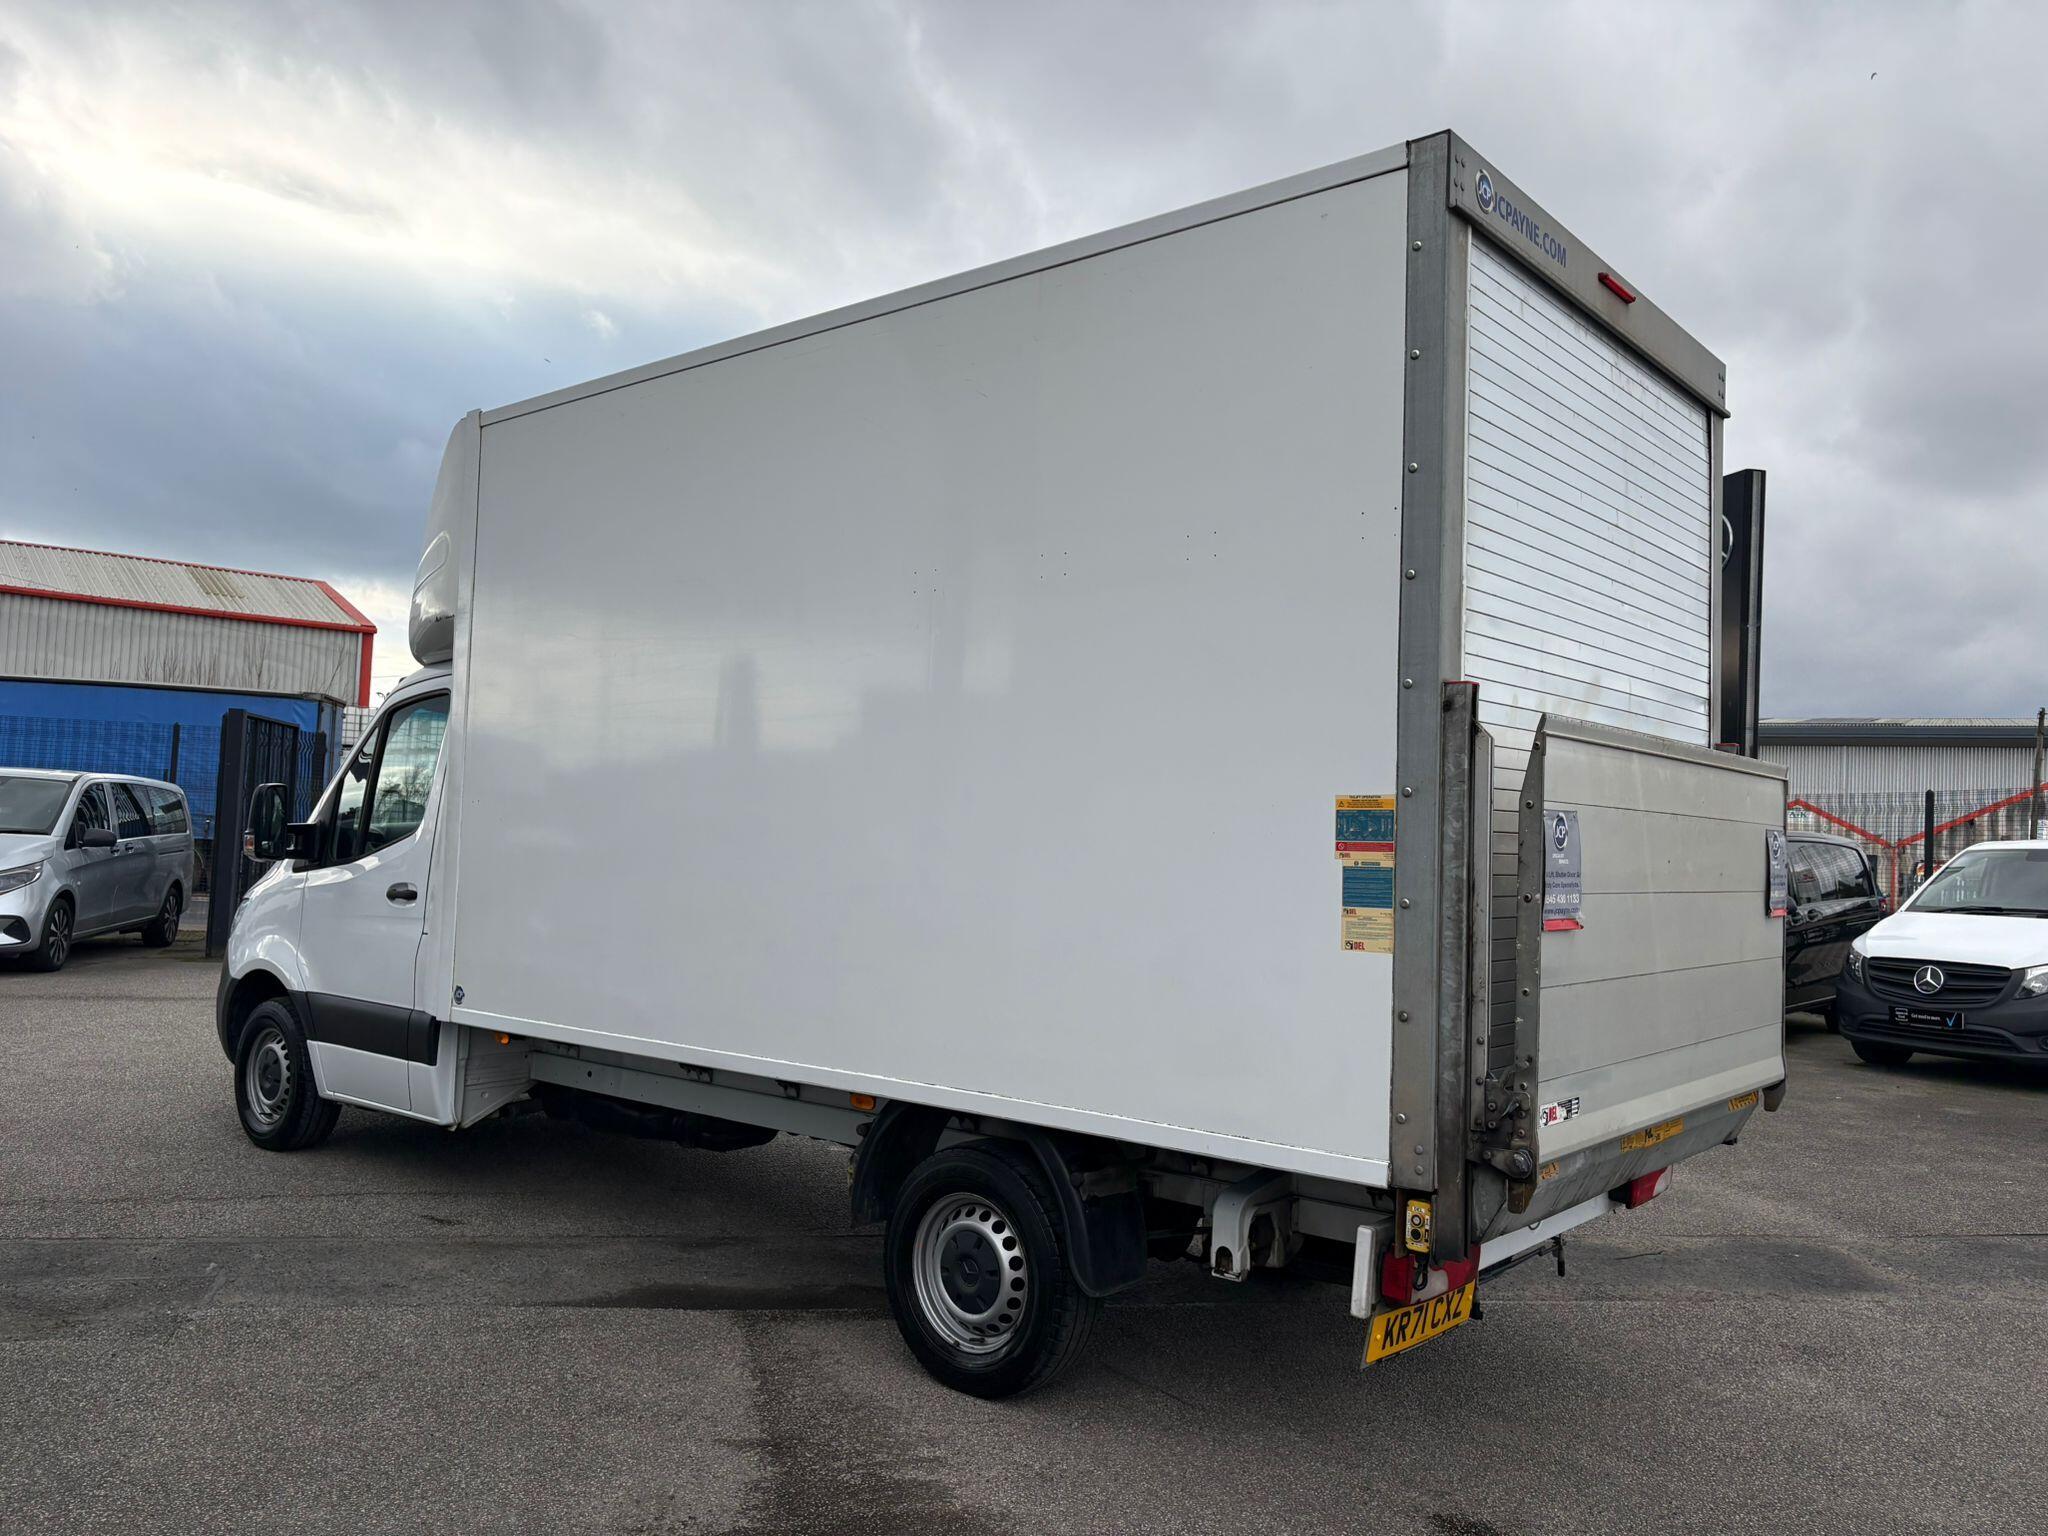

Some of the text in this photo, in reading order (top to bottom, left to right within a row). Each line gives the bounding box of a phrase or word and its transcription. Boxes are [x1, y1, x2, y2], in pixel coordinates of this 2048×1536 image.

[1493, 191, 1567, 269] JCPAYNE.COM
[1555, 825, 1566, 838] JCP
[1353, 941, 1366, 951] DEL
